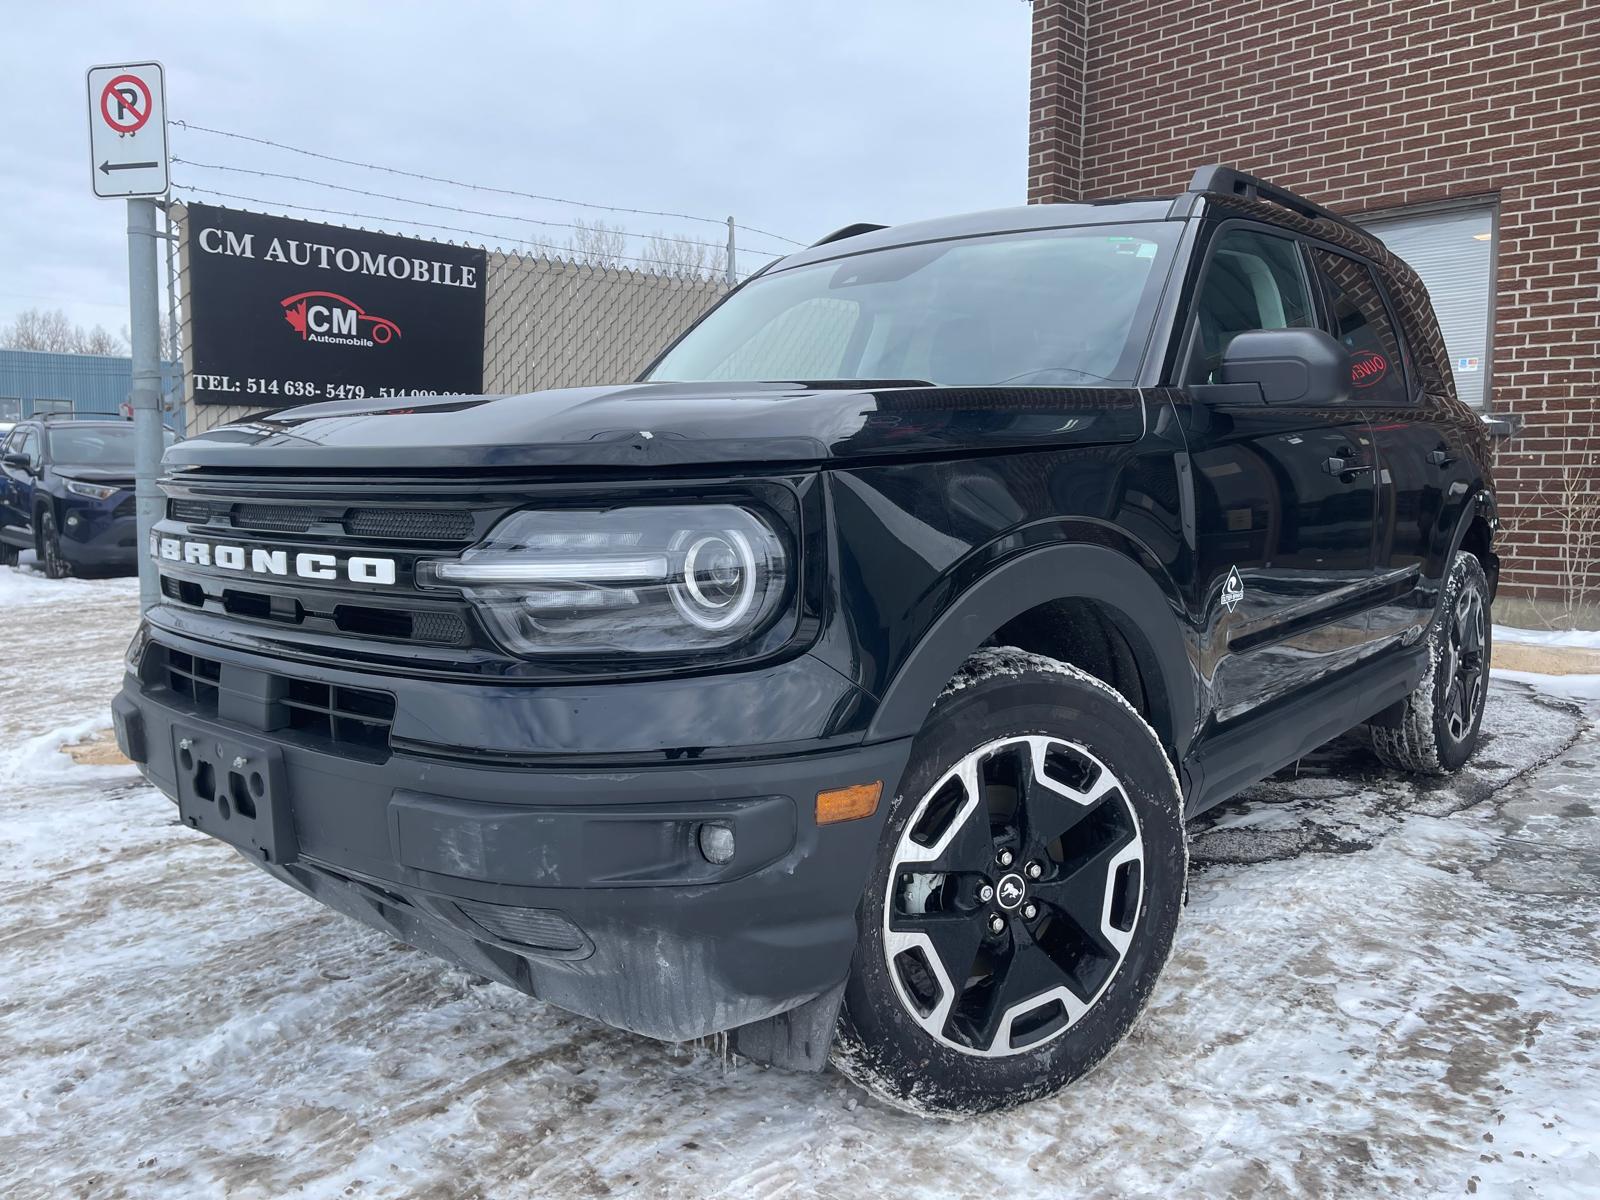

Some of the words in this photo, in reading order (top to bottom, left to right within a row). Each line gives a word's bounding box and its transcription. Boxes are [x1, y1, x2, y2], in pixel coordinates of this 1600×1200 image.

[199, 228, 255, 259] CM
[264, 237, 477, 289] AUTOMOBILE
[307, 305, 357, 336] CM
[308, 333, 374, 347] Automobile
[193, 374, 241, 392] TEL:
[246, 378, 279, 394] 514
[326, 383, 365, 399] 5479
[161, 538, 396, 585] BRONCO
